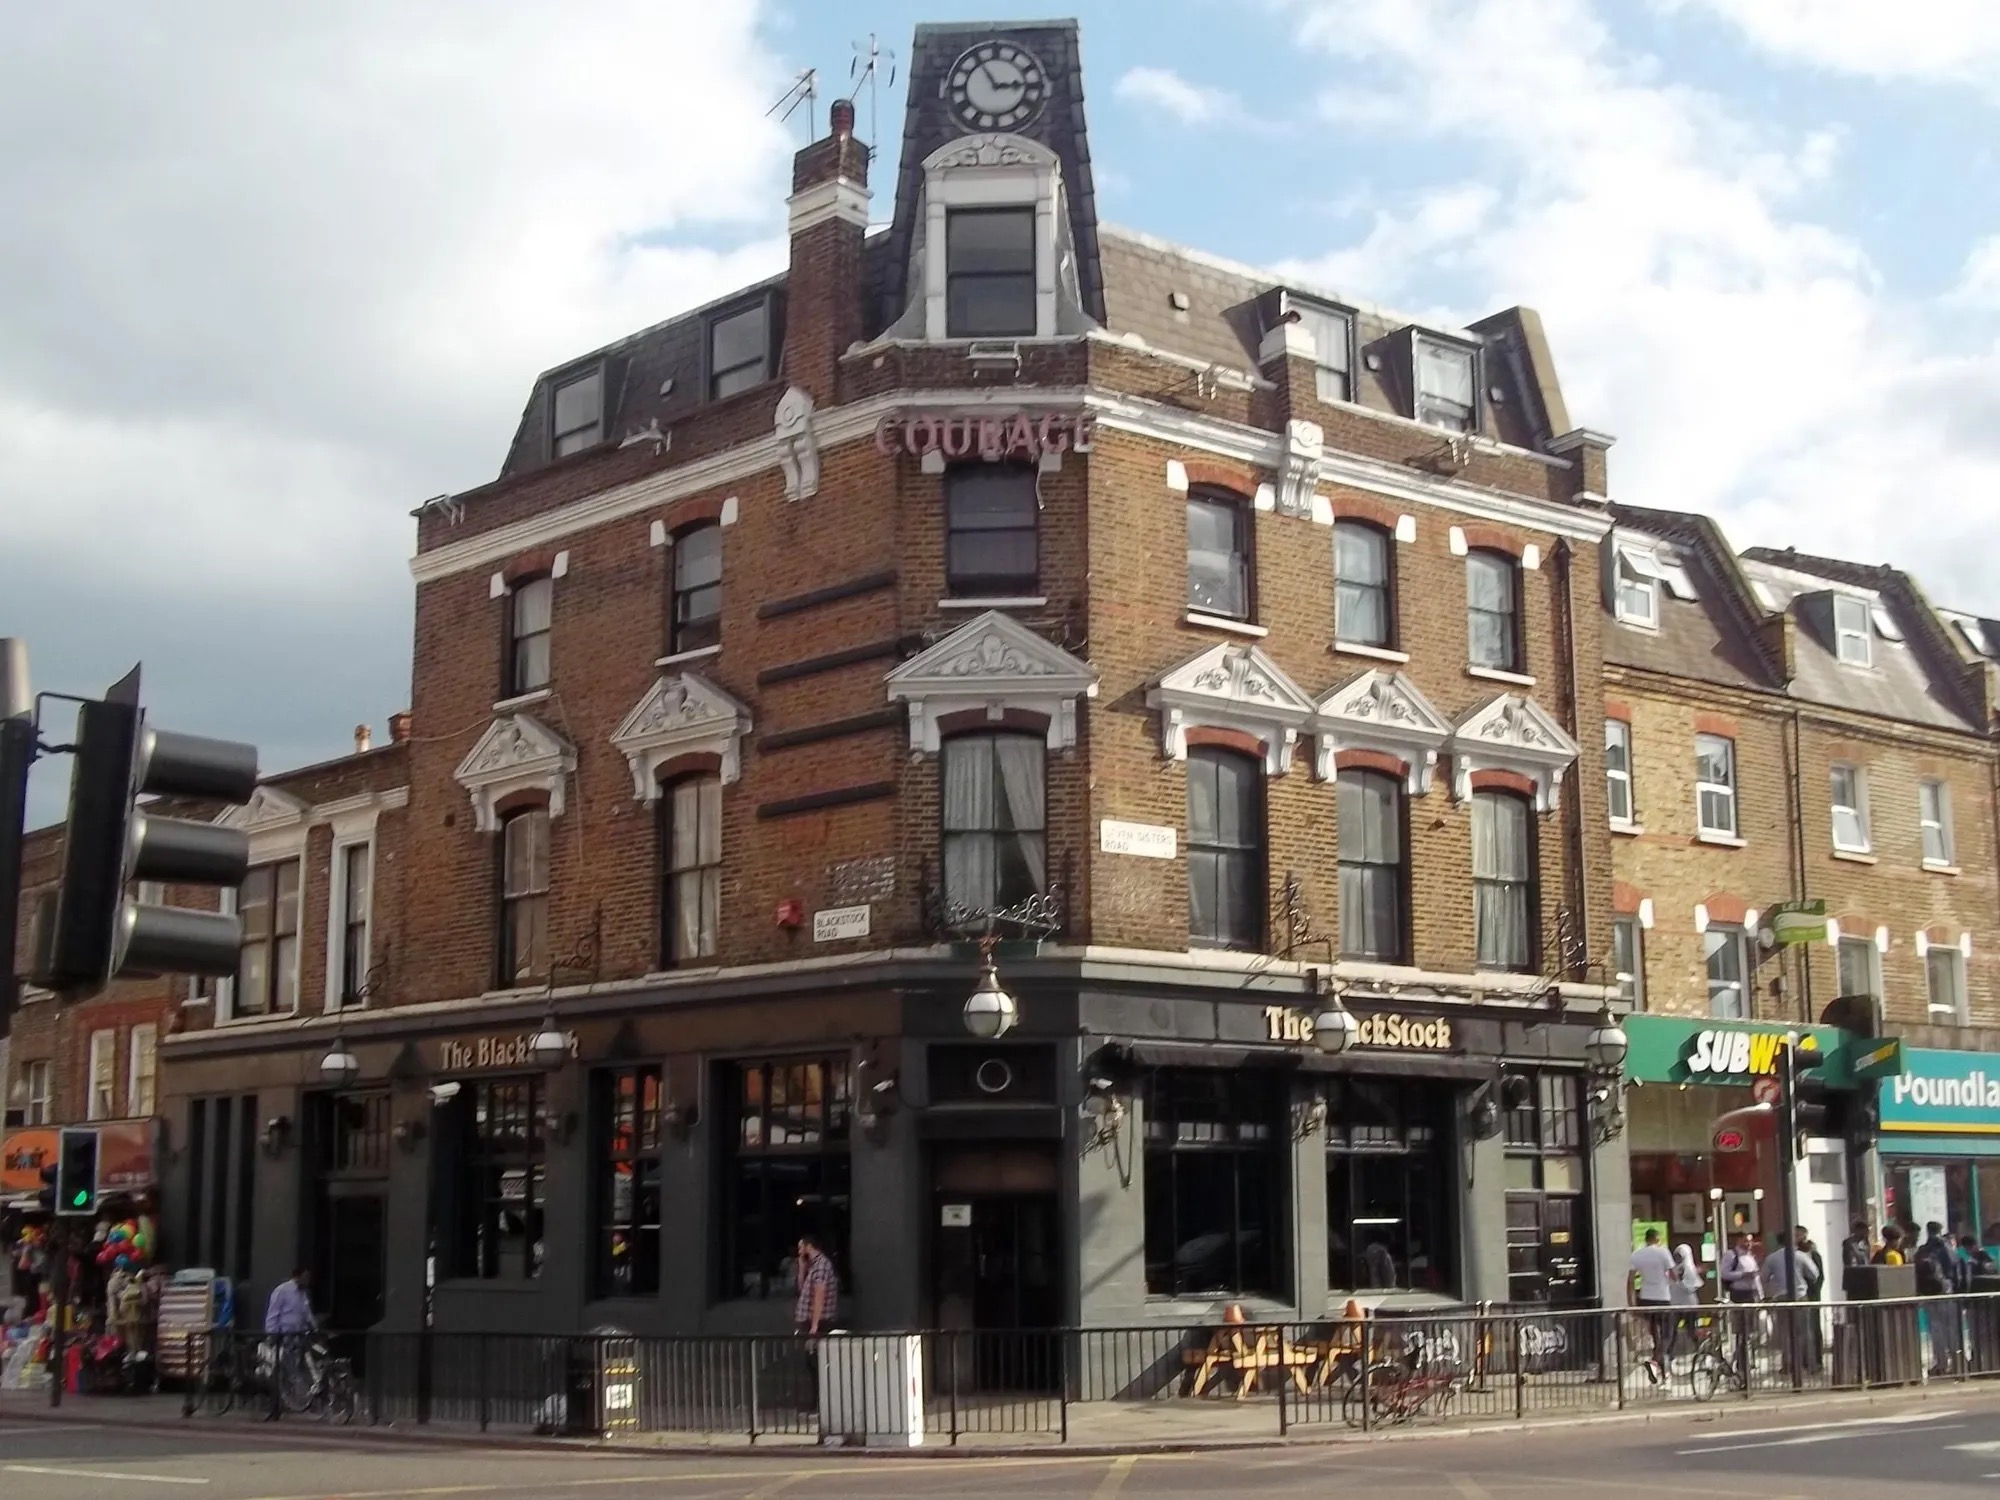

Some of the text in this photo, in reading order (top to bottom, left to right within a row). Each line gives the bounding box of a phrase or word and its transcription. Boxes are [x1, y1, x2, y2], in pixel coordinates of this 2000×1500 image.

[876, 413, 1093, 457] COURAGE
[1104, 839, 1129, 852] ROAD
[1137, 830, 1173, 846] SISTERS
[816, 912, 866, 928] BLACKSTOCK
[816, 927, 838, 939] ROAD
[1265, 1005, 1451, 1048] The ckStock
[440, 1030, 579, 1069] The Blackk
